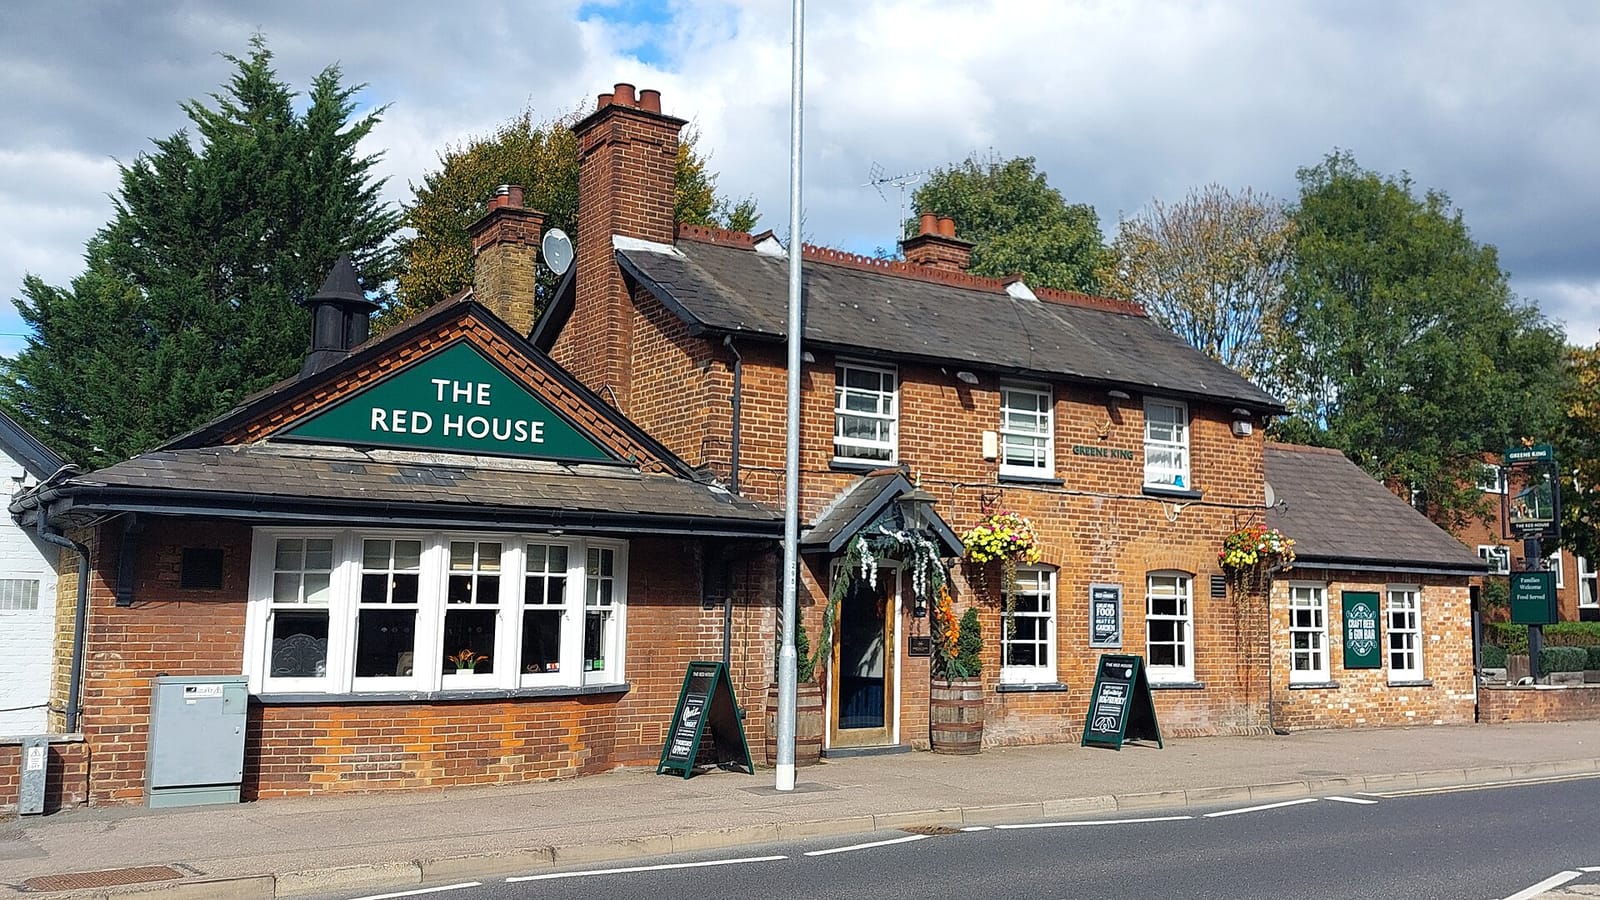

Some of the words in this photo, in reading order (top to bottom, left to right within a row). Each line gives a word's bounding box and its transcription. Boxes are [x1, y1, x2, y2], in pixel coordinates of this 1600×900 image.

[431, 378, 491, 405] THE
[371, 408, 433, 434] RED
[443, 414, 545, 443] HOUSE
[1073, 445, 1107, 457] GREENE
[1110, 449, 1133, 460] KING
[1509, 451, 1531, 459] GREENE
[1529, 593, 1546, 601] Served
[1095, 608, 1115, 616] FOOD
[1348, 619, 1363, 628] CRAFT
[1363, 619, 1375, 628] BEER
[1364, 629, 1375, 639] BAR
